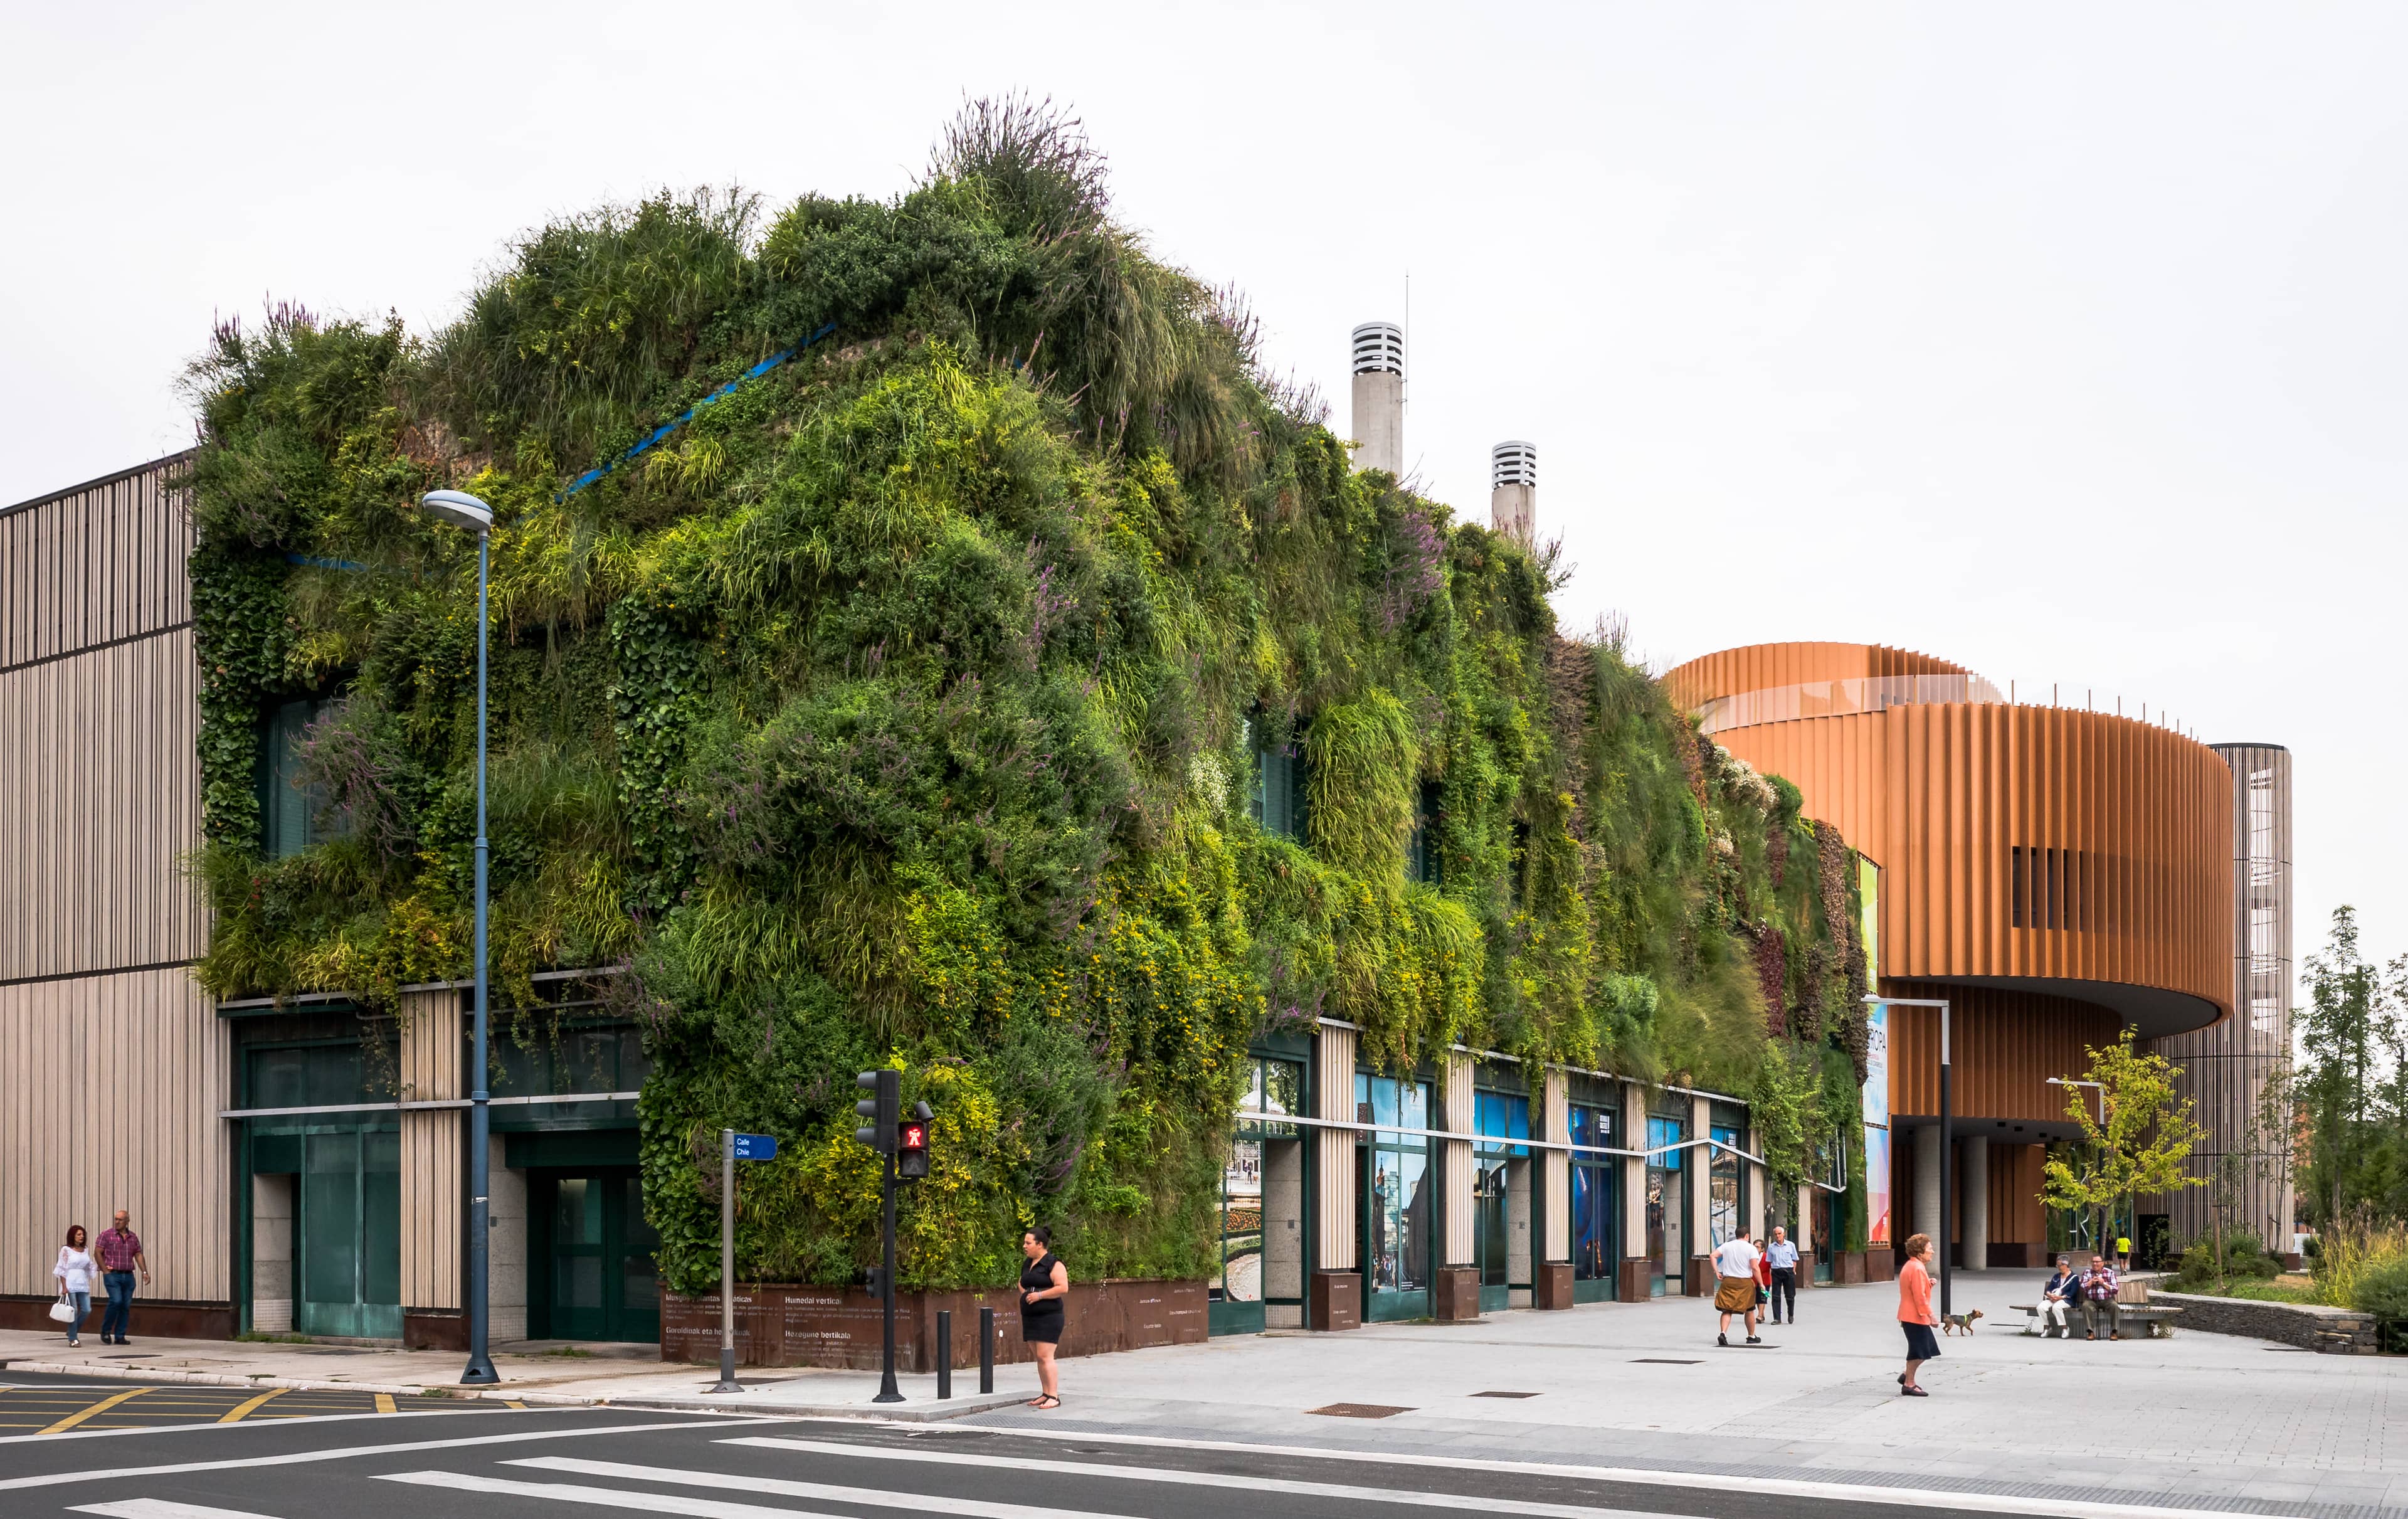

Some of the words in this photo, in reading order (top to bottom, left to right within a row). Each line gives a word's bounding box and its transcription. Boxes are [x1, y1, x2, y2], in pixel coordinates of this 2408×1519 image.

[666, 1326, 700, 1335] Goroldioak
[785, 1330, 819, 1339] Hezegune
[821, 1331, 851, 1339] bertikala
